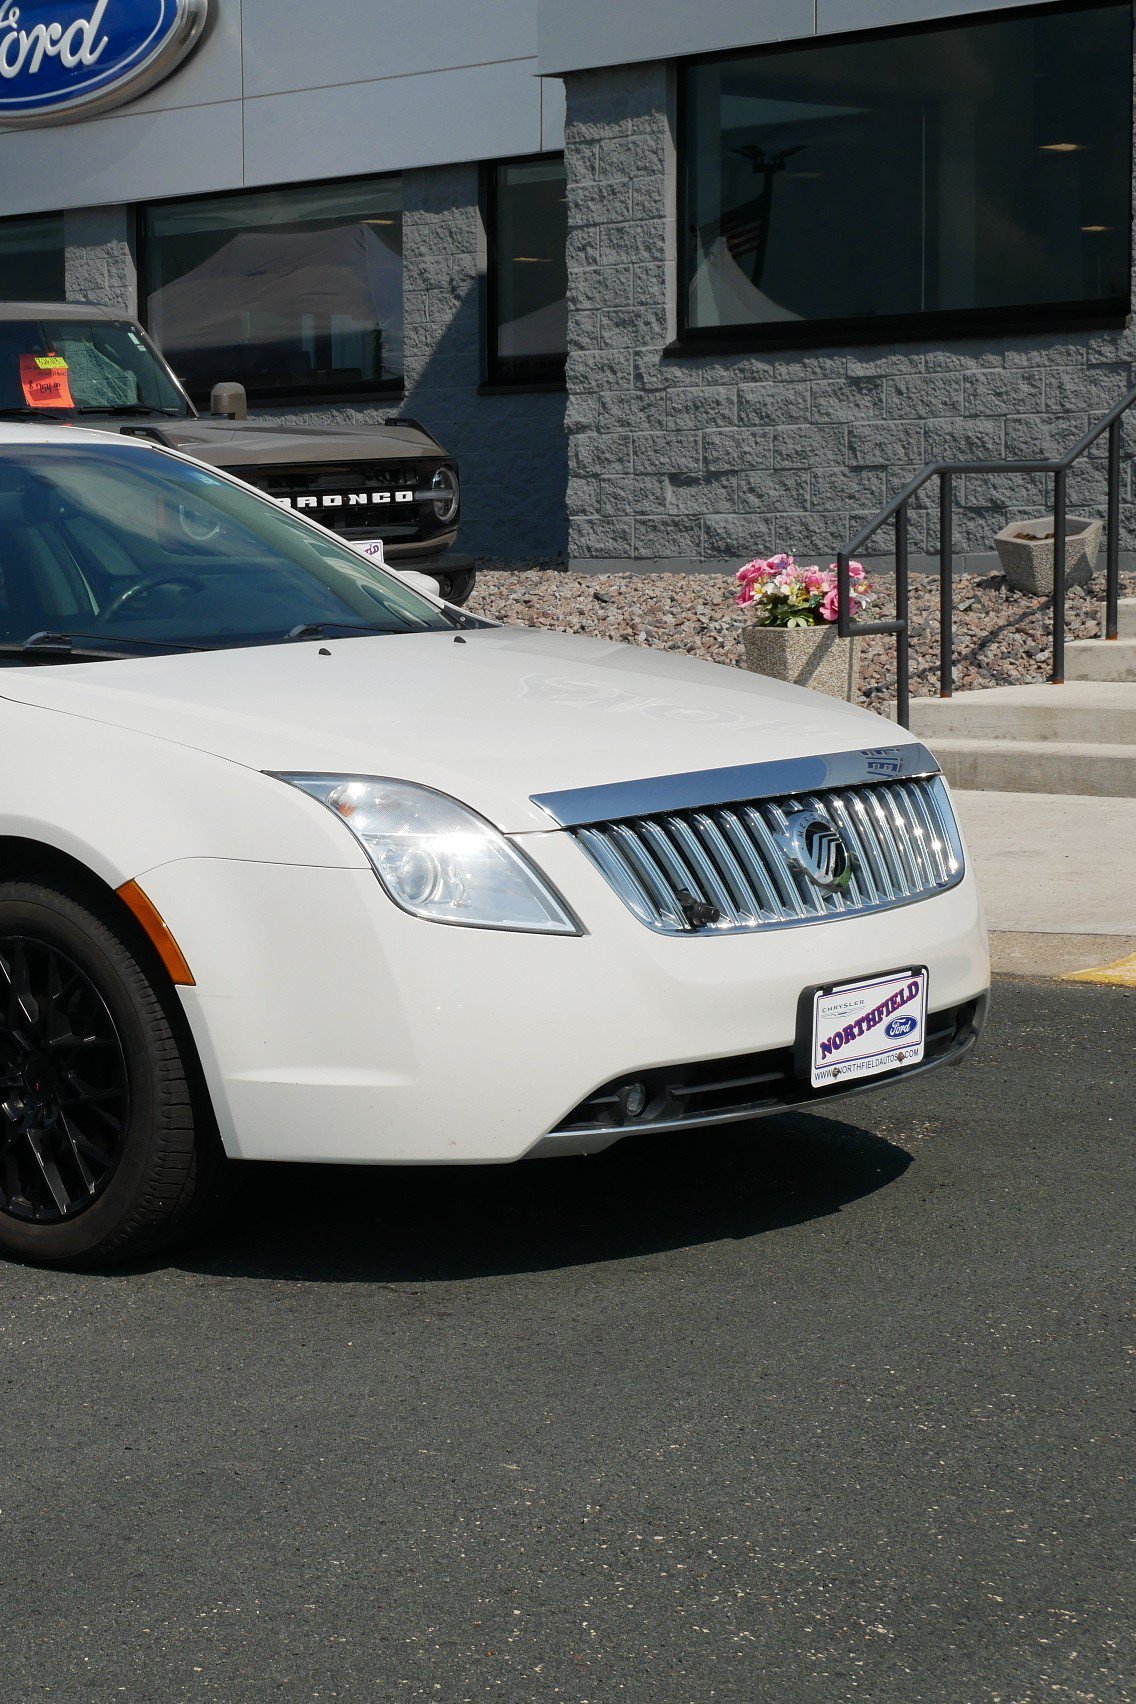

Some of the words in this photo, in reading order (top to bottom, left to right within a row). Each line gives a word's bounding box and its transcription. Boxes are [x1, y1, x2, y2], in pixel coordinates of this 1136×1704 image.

[821, 999, 865, 1013] CHRYSLER
[819, 980, 920, 1060] NORTHFIELD
[889, 1017, 911, 1035] Ford
[814, 1048, 919, 1081] WWWNORTHFIELDAUTOSCOM
